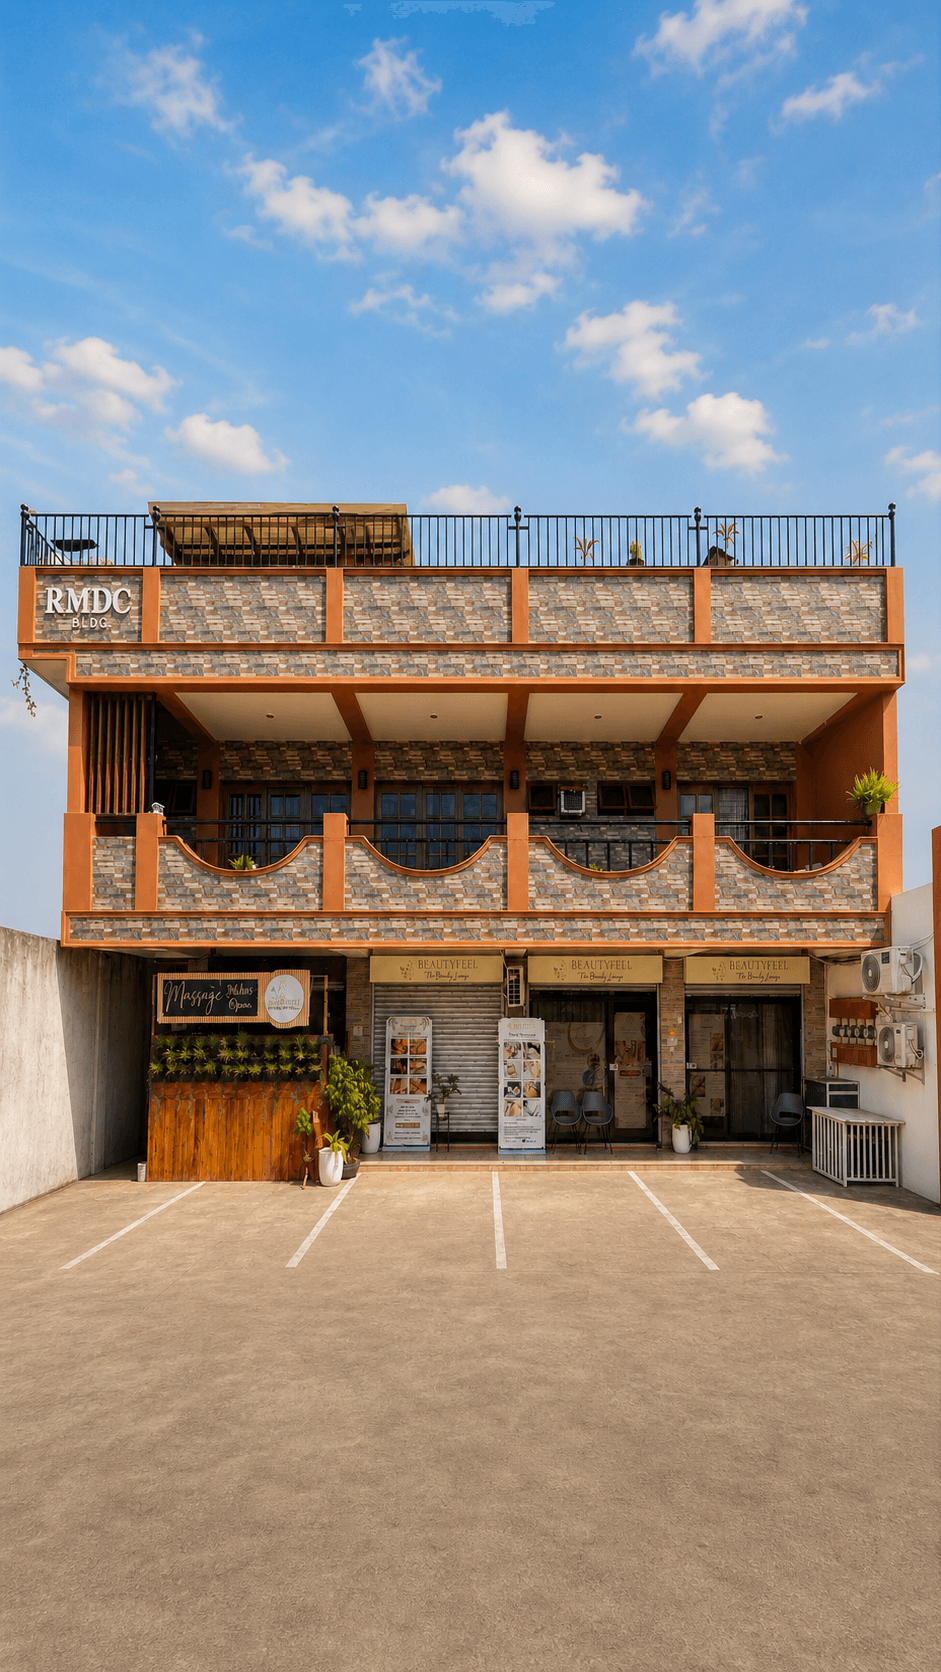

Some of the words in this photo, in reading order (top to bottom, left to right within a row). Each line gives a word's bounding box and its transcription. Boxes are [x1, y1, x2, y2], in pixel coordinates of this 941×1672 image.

[45, 587, 131, 614] RMDC
[418, 959, 479, 969] BEAUTYFEEL
[571, 959, 633, 970] BEAUTYFEEL
[729, 960, 789, 970] BEAUTYFEEL
[164, 981, 224, 1015] Massage
